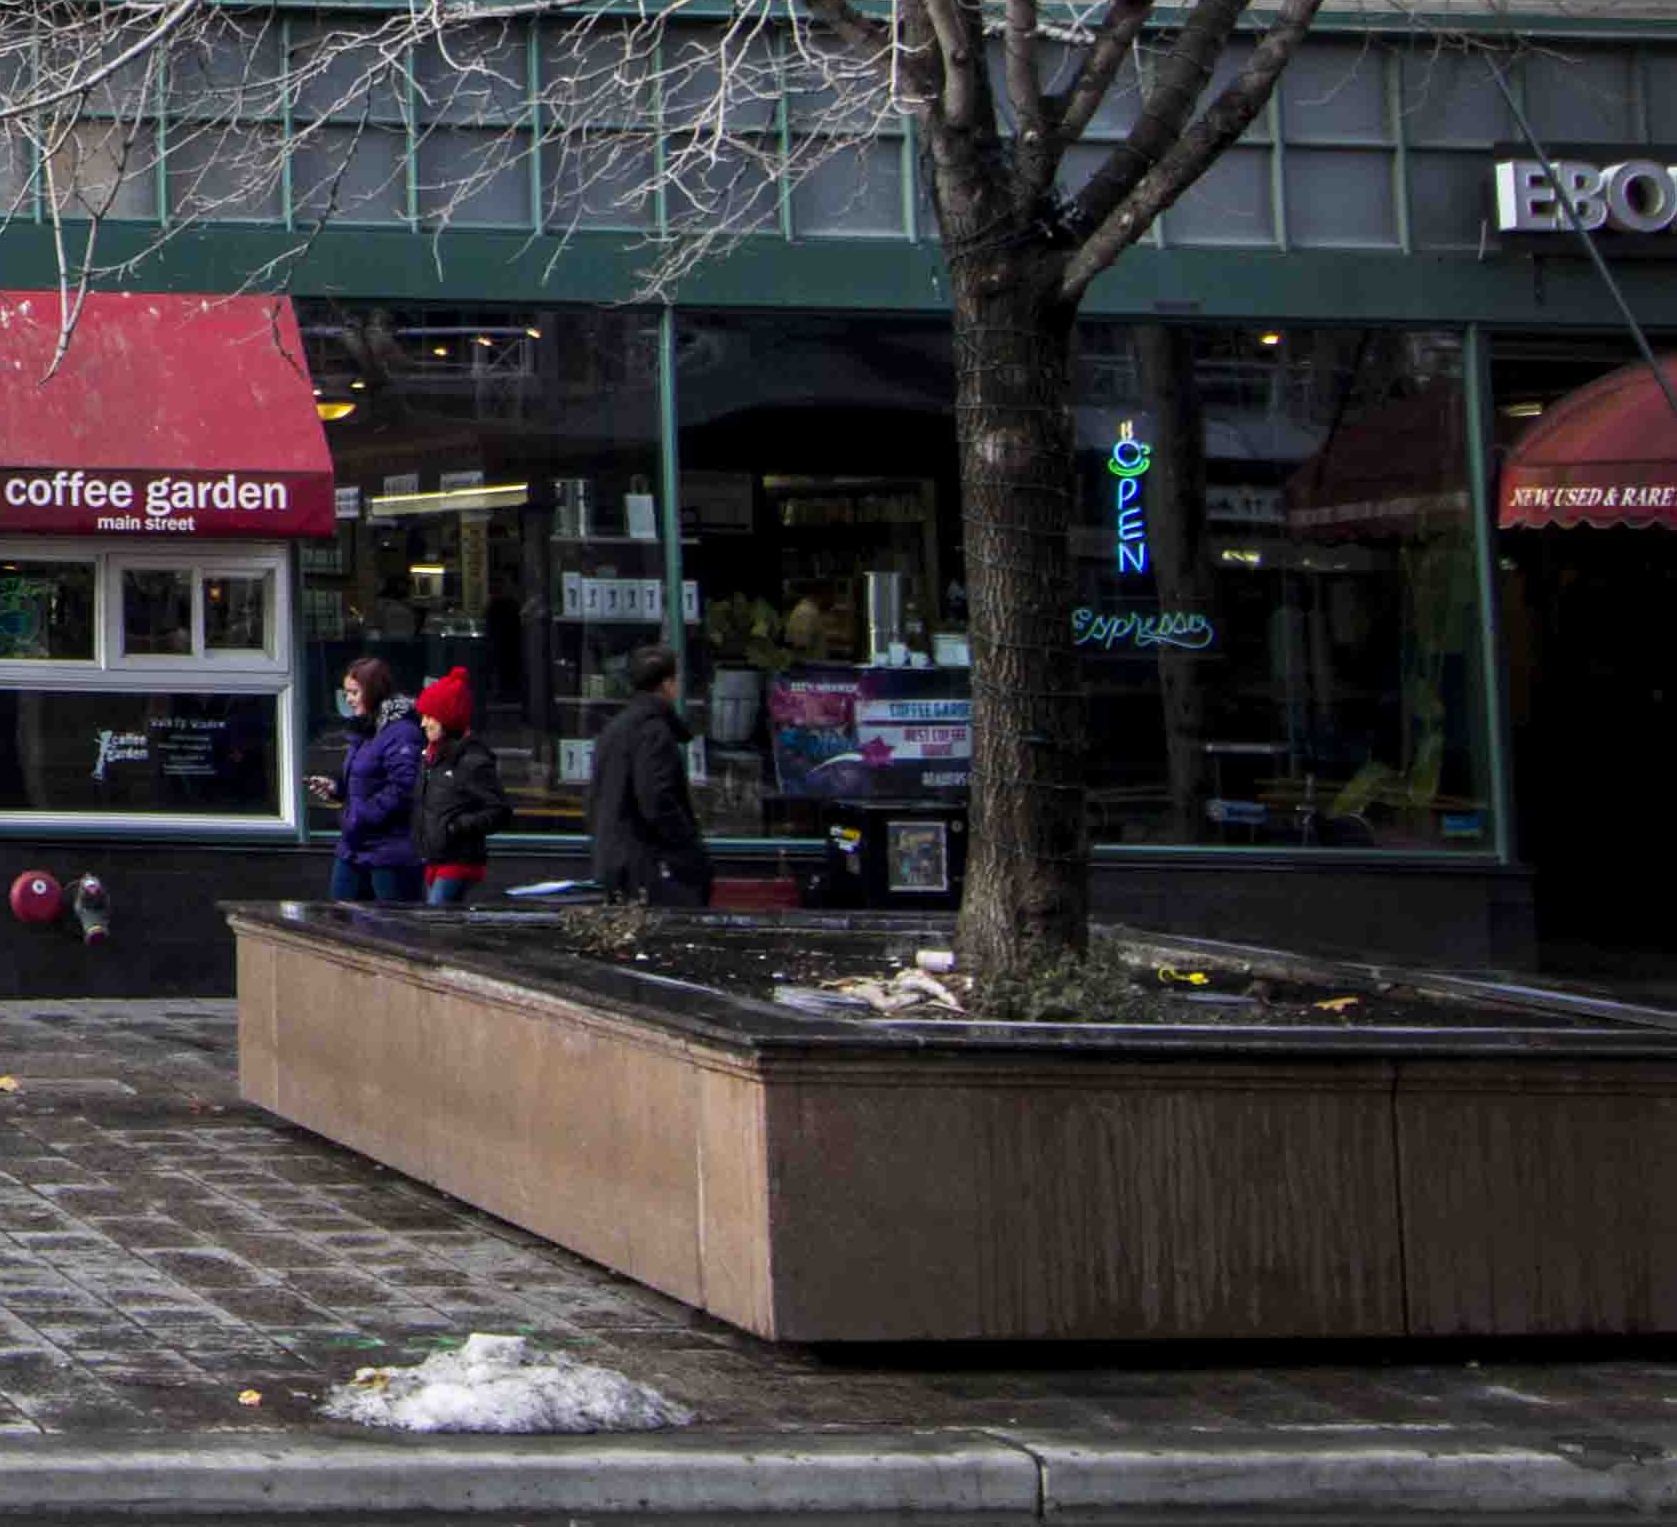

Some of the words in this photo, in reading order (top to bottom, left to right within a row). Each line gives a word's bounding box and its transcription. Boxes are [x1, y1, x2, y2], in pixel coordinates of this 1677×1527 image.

[1496, 159, 1677, 233] EBO
[4, 470, 133, 508] coffee
[145, 474, 288, 517] garden
[1112, 438, 1147, 573] OPEN
[1553, 486, 1603, 507] USED
[1620, 486, 1674, 507] RARE
[97, 515, 141, 531] main
[144, 515, 196, 531] street
